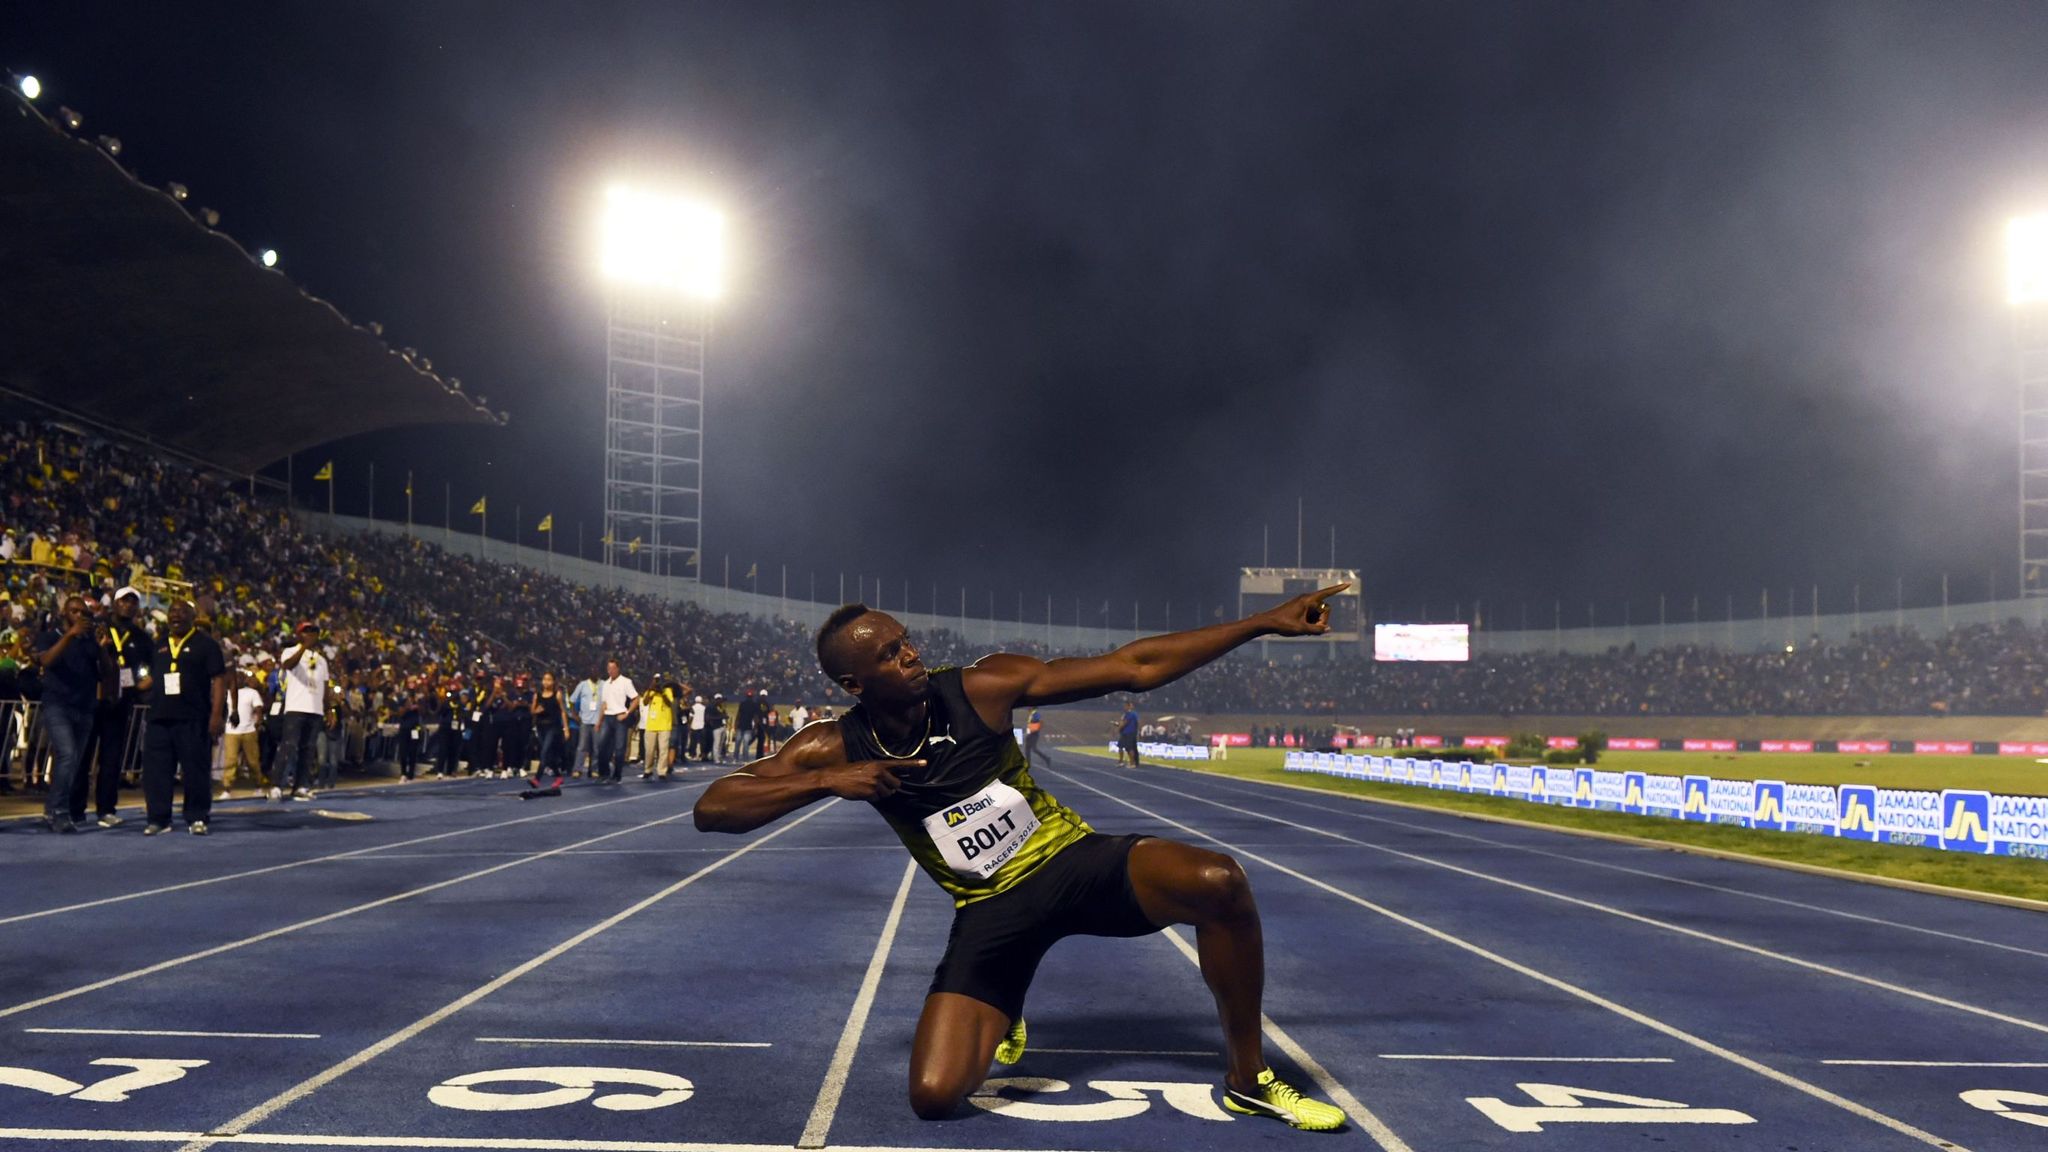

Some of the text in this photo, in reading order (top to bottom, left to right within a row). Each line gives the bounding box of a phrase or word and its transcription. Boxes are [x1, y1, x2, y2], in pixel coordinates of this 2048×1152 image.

[1711, 784, 1752, 797] JAMAICA
[1786, 788, 1834, 803] JAMAICA
[963, 794, 996, 816] Bank
[1711, 798, 1753, 812] NATIONAL
[1878, 794, 1939, 811] JAMAICA
[1786, 805, 1836, 821] NATIONAL
[1878, 812, 1940, 830] NATIONAL
[957, 810, 1016, 860] BOLT
[1890, 831, 1927, 846] GROUP
[983, 841, 1019, 872] RACERS
[427, 1066, 694, 1113] 6
[1465, 1082, 1757, 1134] 4
